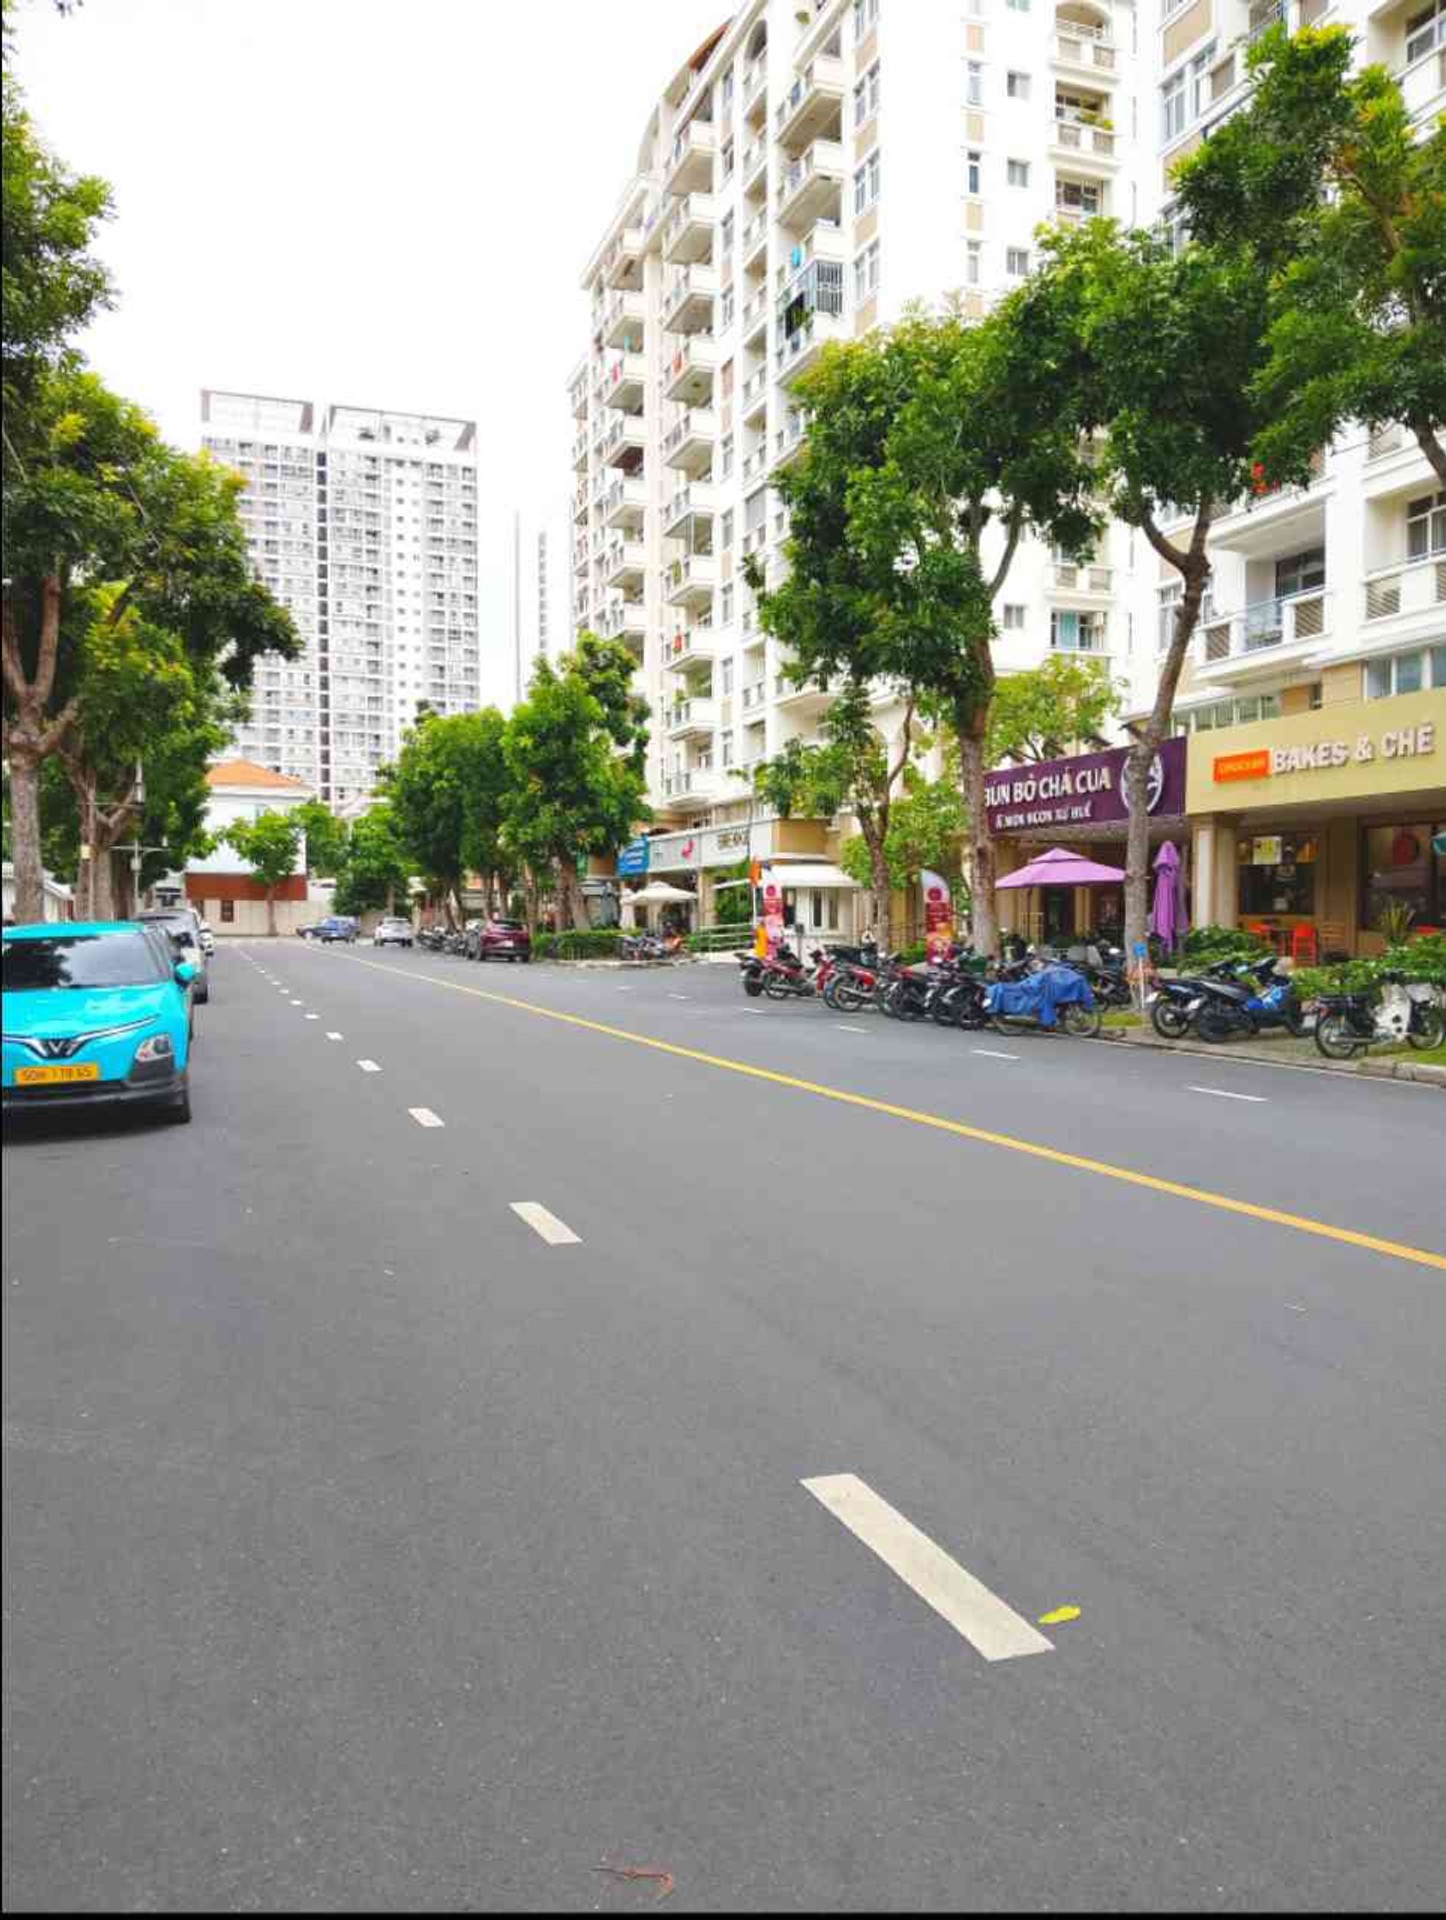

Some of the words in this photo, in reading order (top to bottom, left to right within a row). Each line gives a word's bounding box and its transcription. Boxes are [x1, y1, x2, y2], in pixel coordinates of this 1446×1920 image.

[1273, 742, 1346, 773] BAKES
[1355, 734, 1372, 761] &
[1076, 767, 1111, 793] CUA
